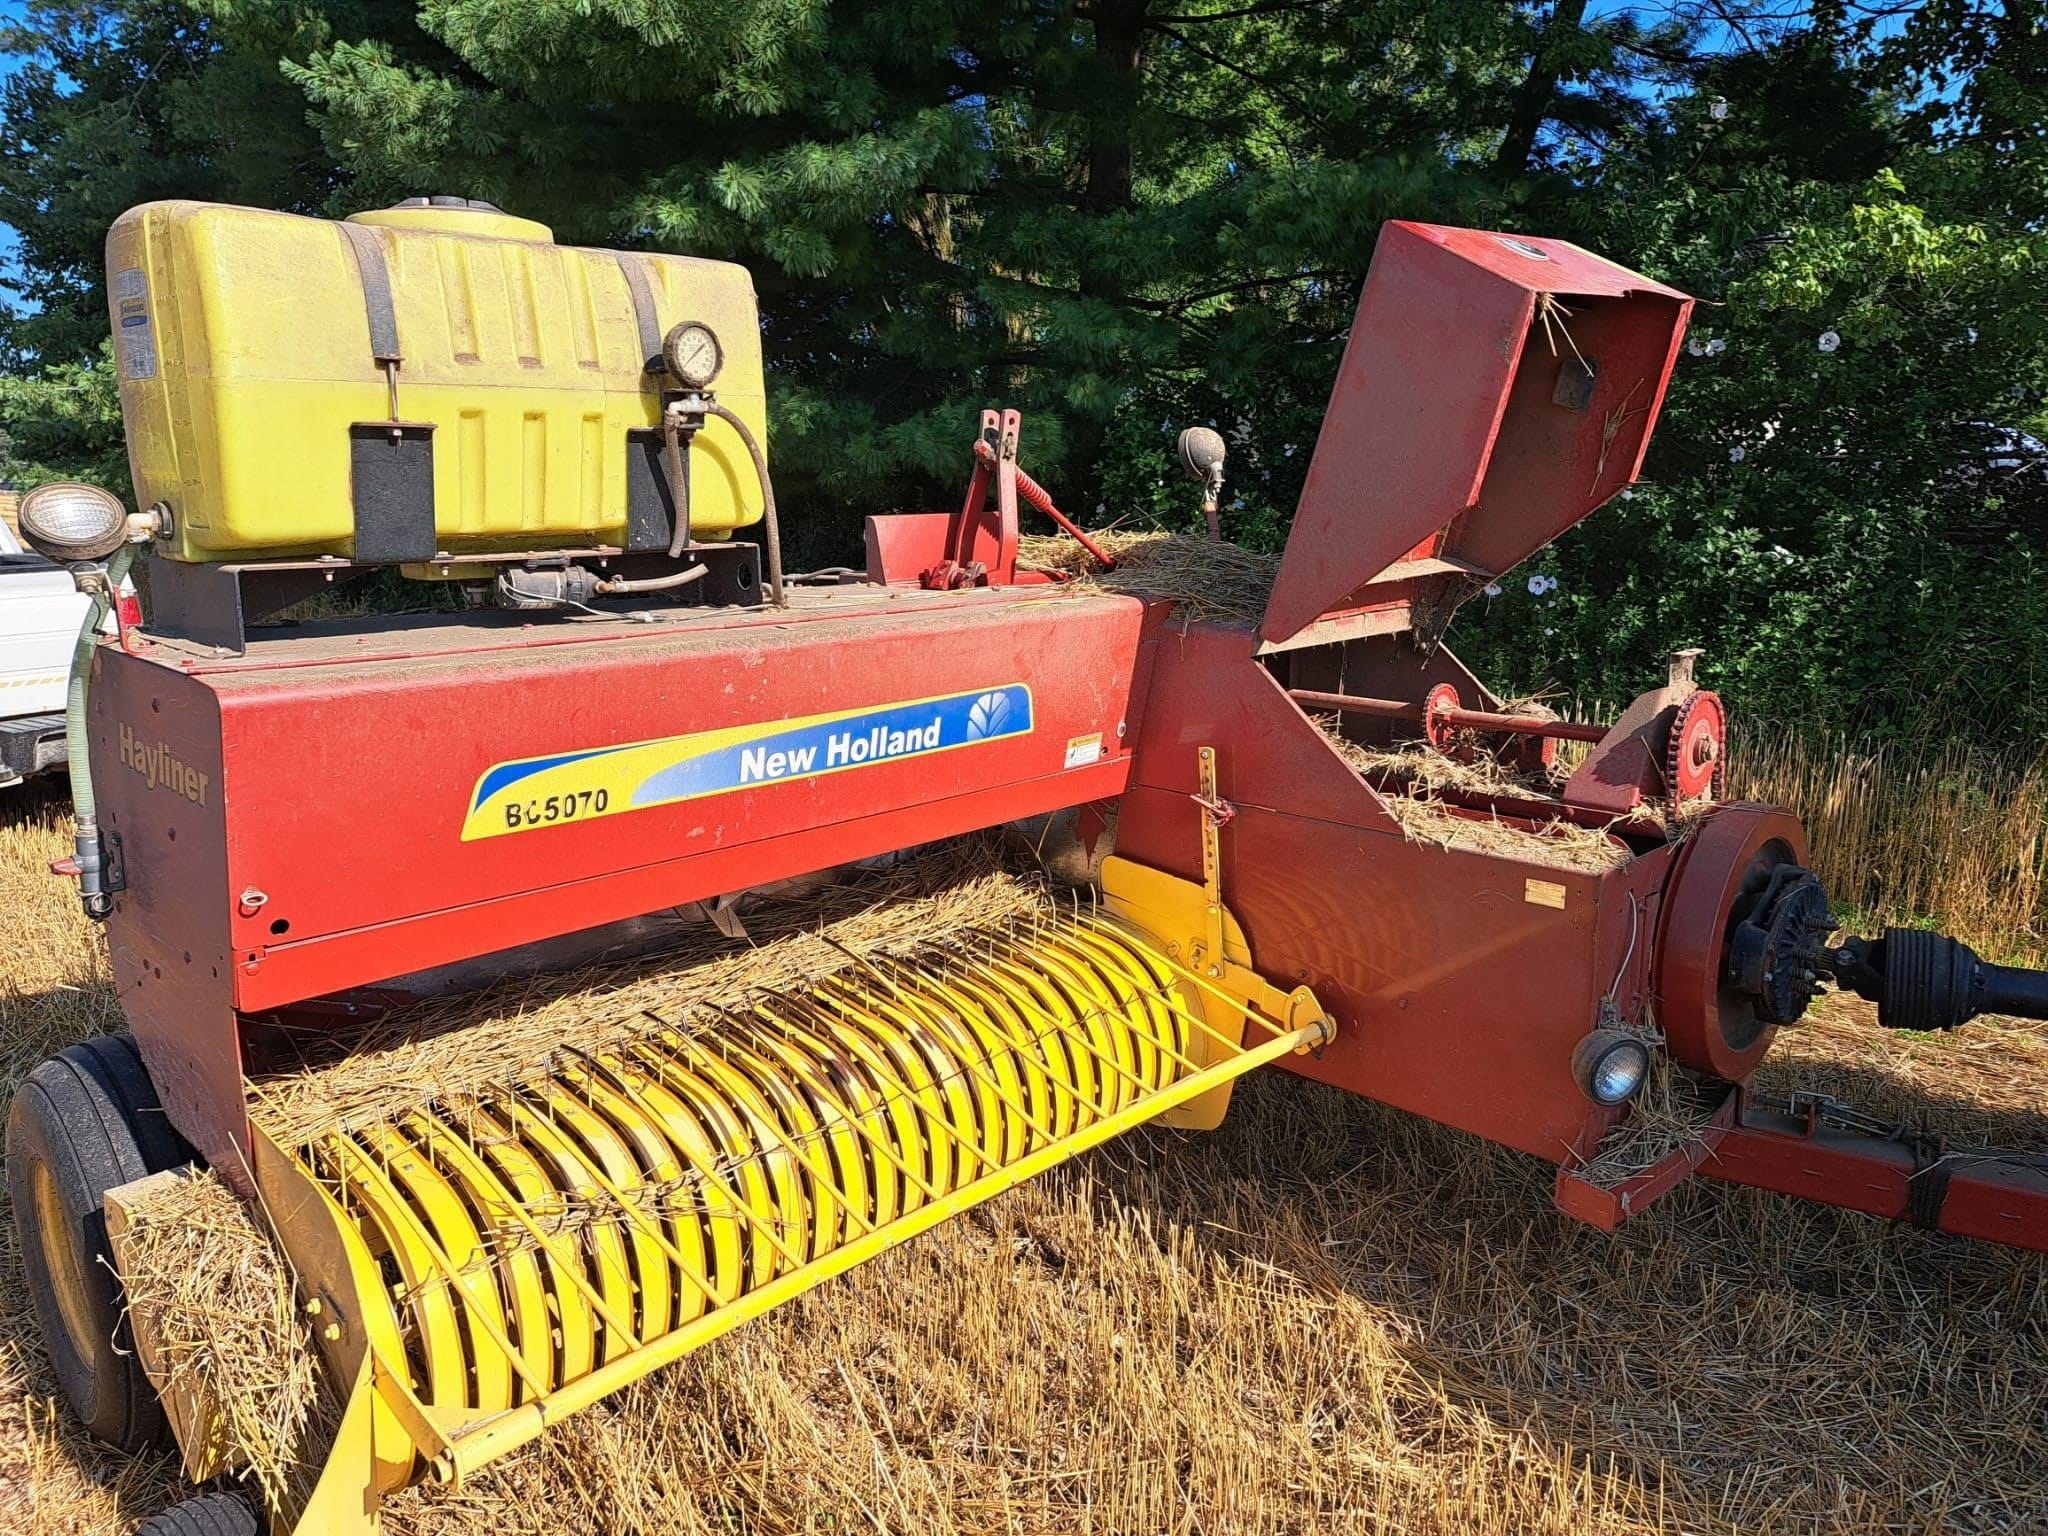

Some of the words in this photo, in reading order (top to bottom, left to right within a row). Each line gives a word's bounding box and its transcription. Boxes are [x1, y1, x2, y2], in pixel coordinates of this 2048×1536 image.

[119, 722, 209, 807] Hayliner
[740, 746, 816, 783] New
[826, 717, 940, 768] Holland
[505, 788, 609, 828] BC5070
